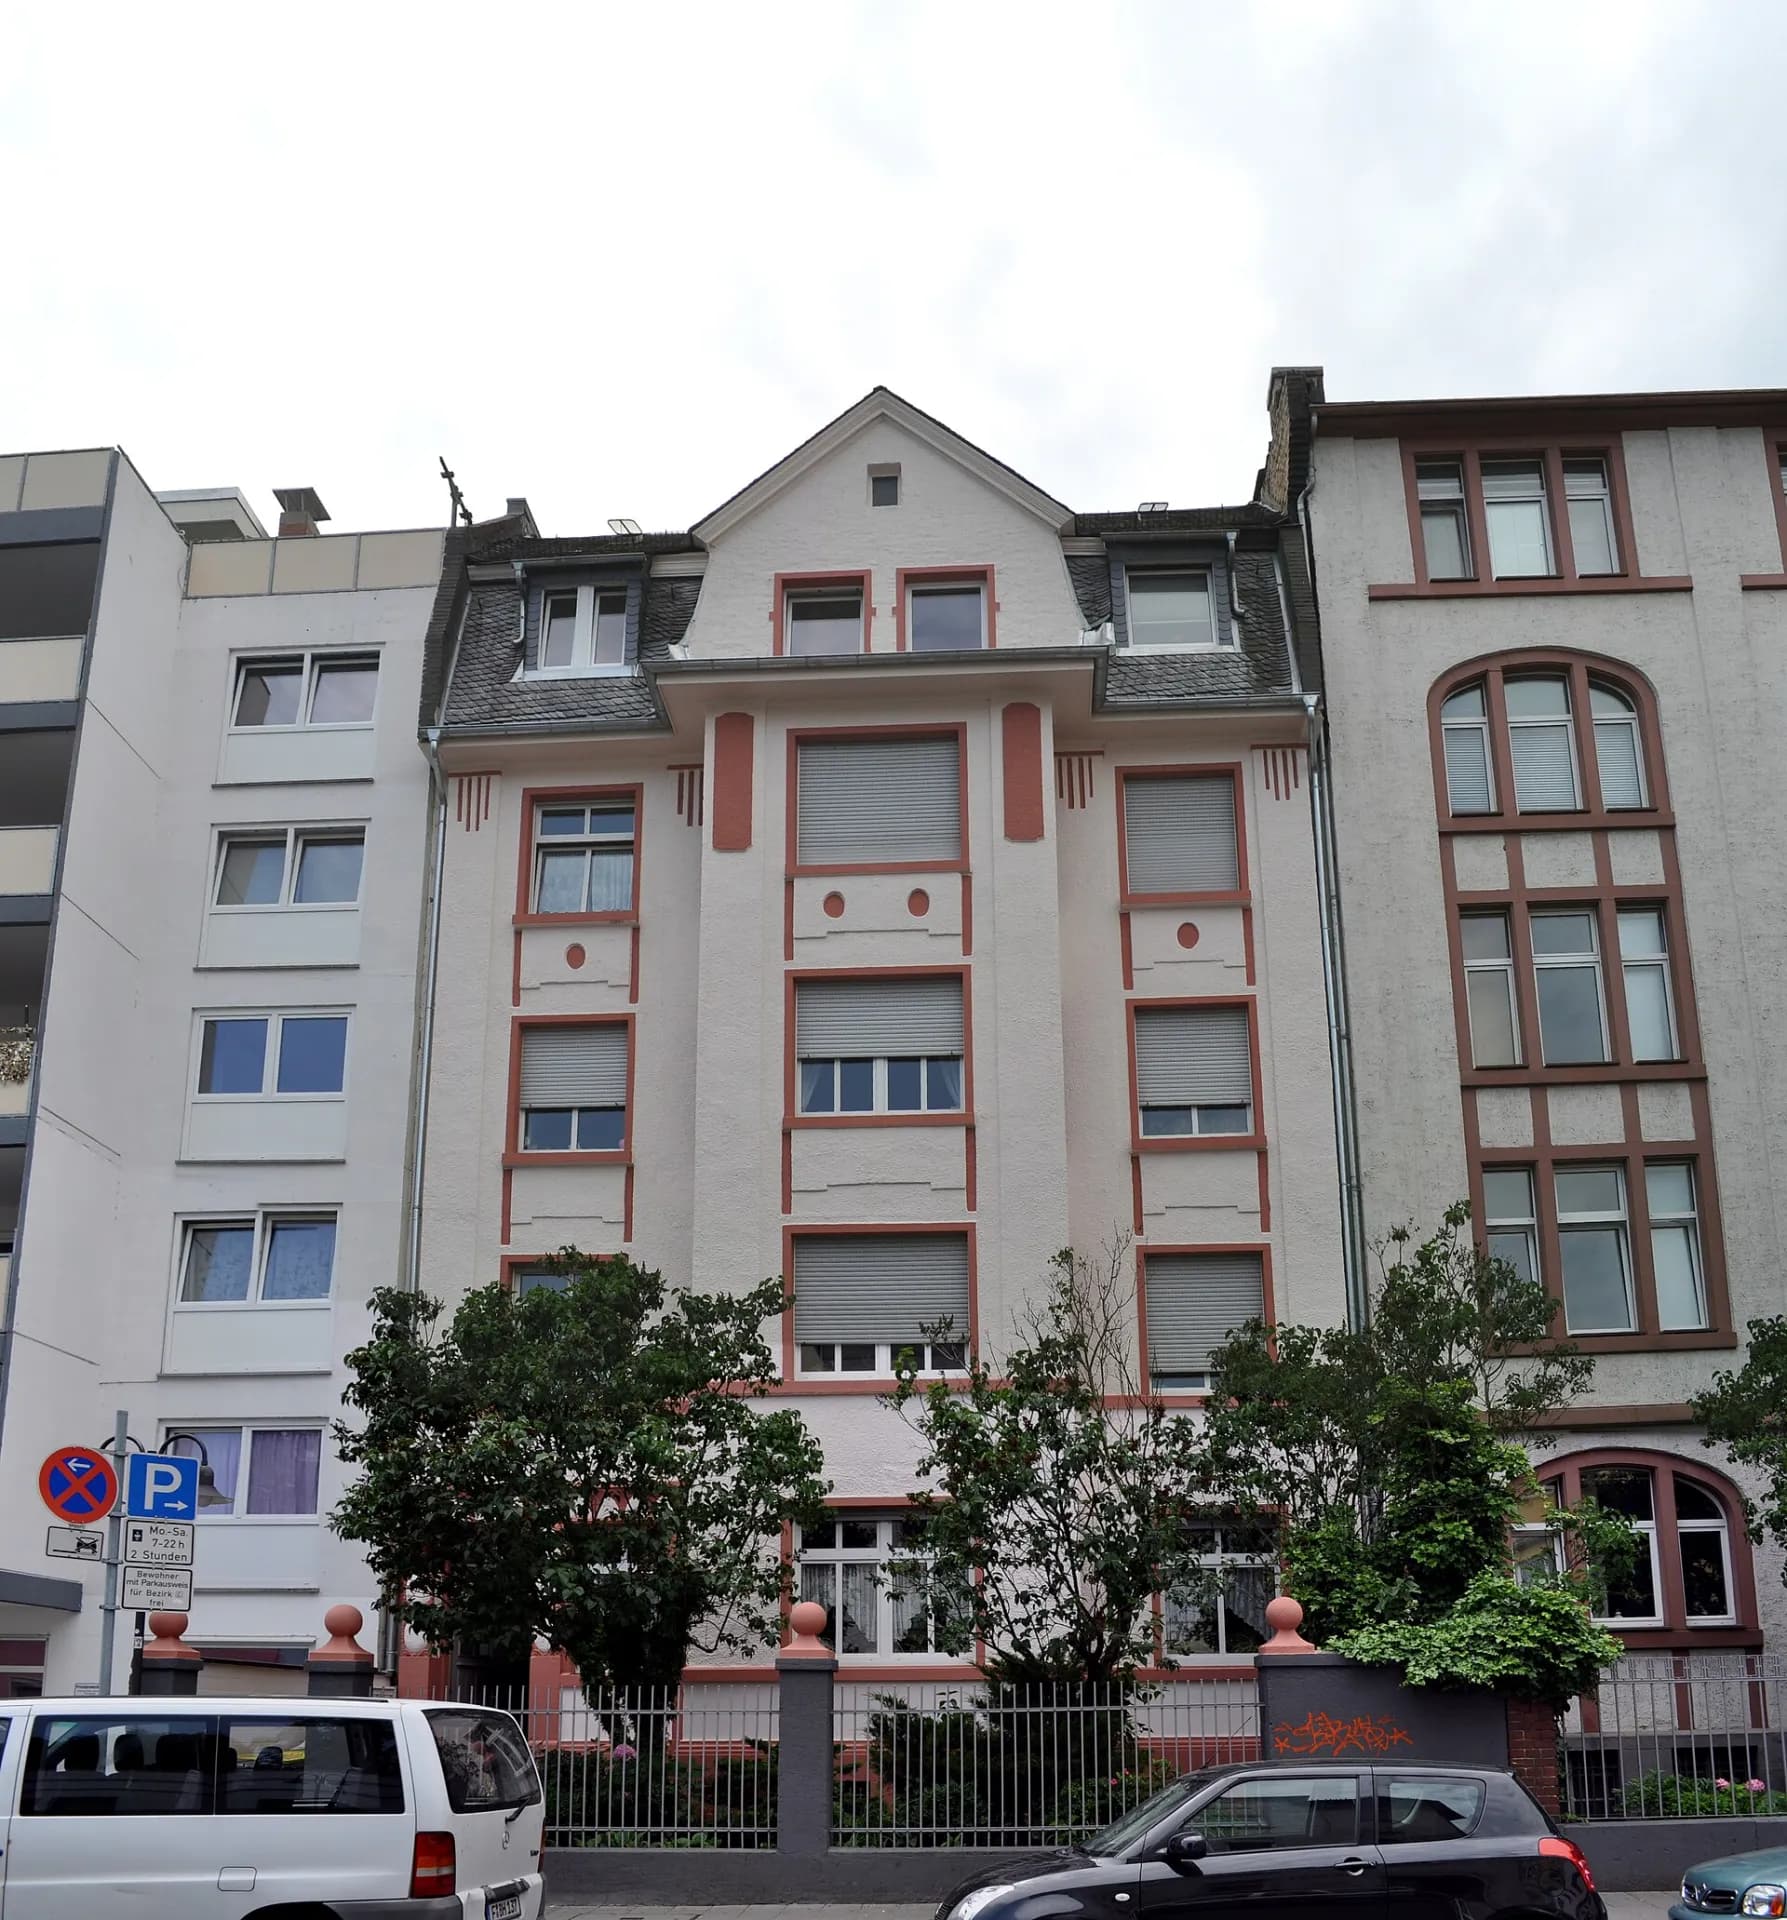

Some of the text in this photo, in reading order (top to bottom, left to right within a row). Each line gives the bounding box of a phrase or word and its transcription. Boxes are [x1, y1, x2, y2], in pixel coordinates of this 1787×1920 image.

[144, 1462, 182, 1510] P
[152, 1538, 185, 1549] 7-22 h
[130, 1549, 187, 1562] 2 Stunden
[137, 1570, 179, 1580] Bewohner
[141, 1578, 188, 1589] Parkausweis
[130, 1588, 142, 1596] für
[146, 1589, 172, 1598] Bezirk
[149, 1599, 164, 1607] frei
